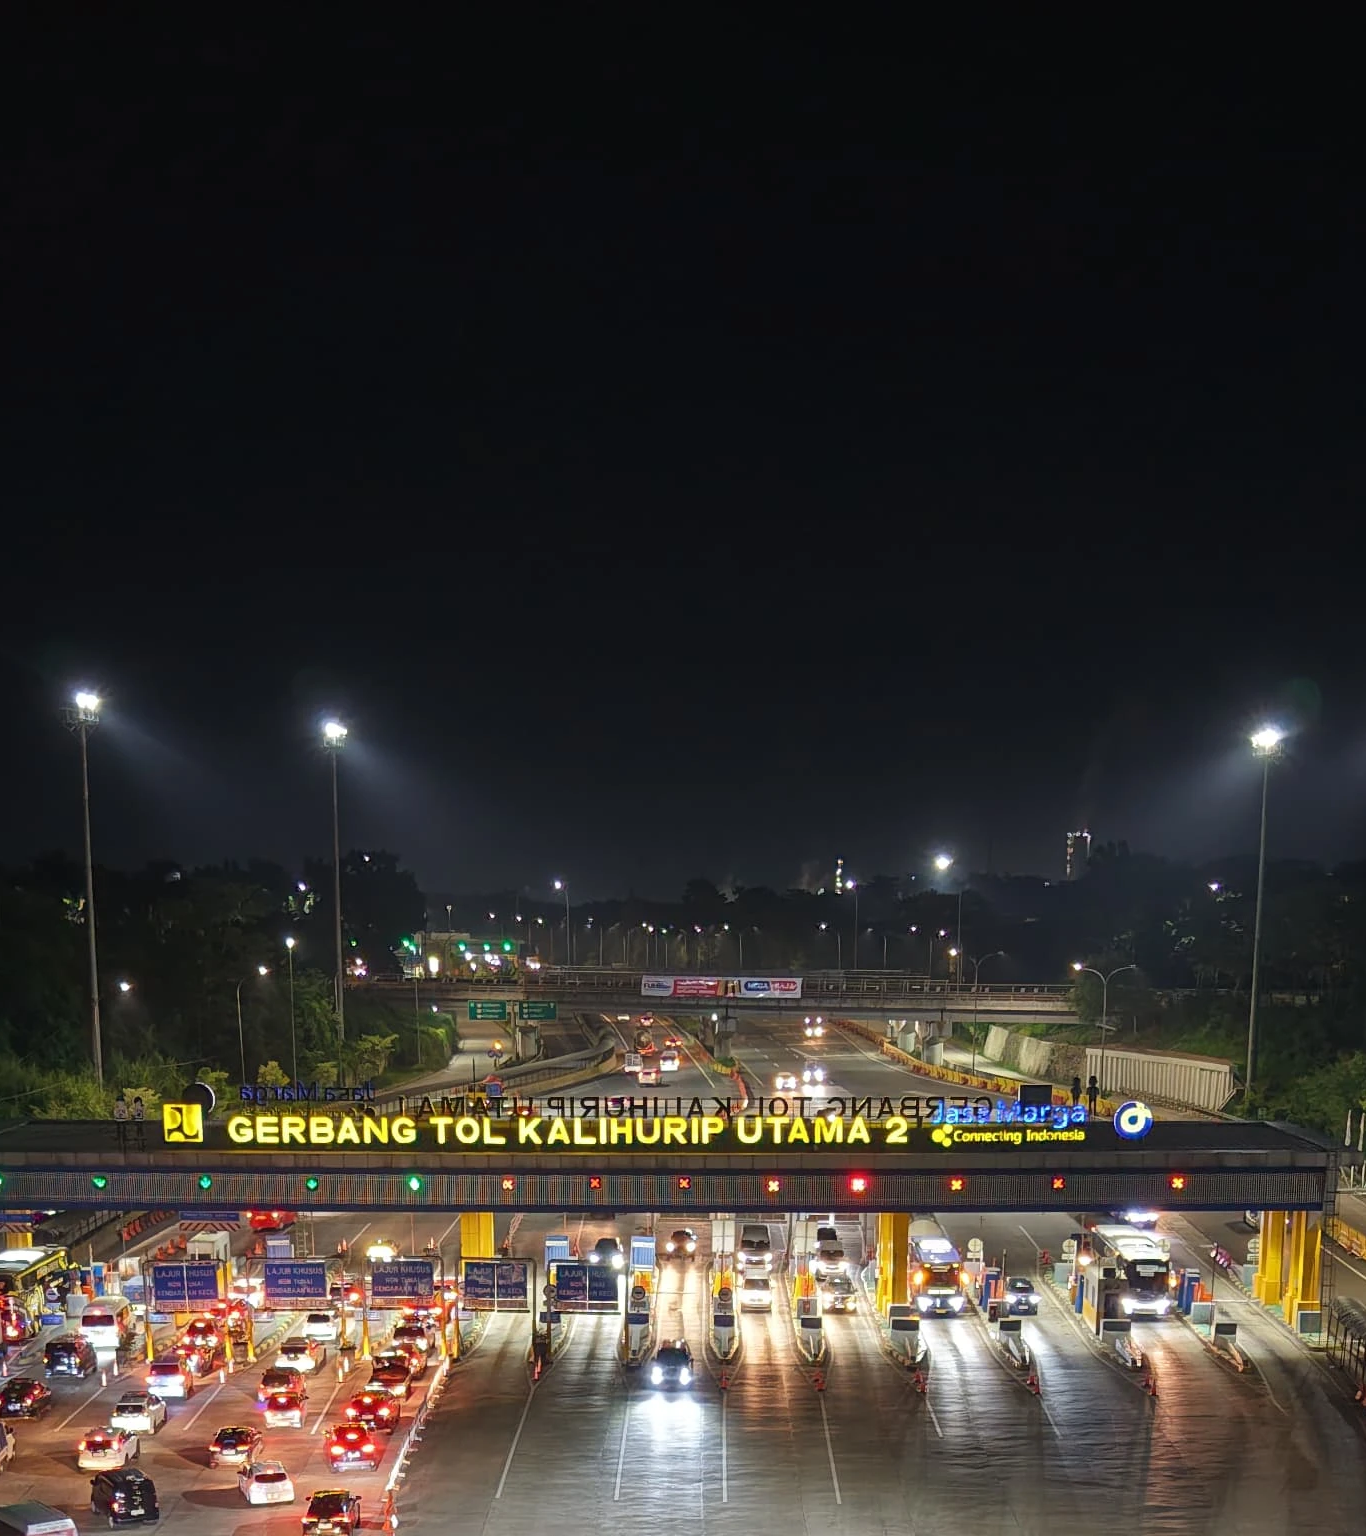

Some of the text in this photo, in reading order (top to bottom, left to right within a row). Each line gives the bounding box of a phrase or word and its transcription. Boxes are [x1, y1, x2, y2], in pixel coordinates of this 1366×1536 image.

[931, 1099, 1087, 1129] Jasa Marga
[228, 1116, 909, 1144] GERBANG TOL KALIHURIP UTAMA 2
[953, 1129, 1085, 1145] Connecting Indonesia
